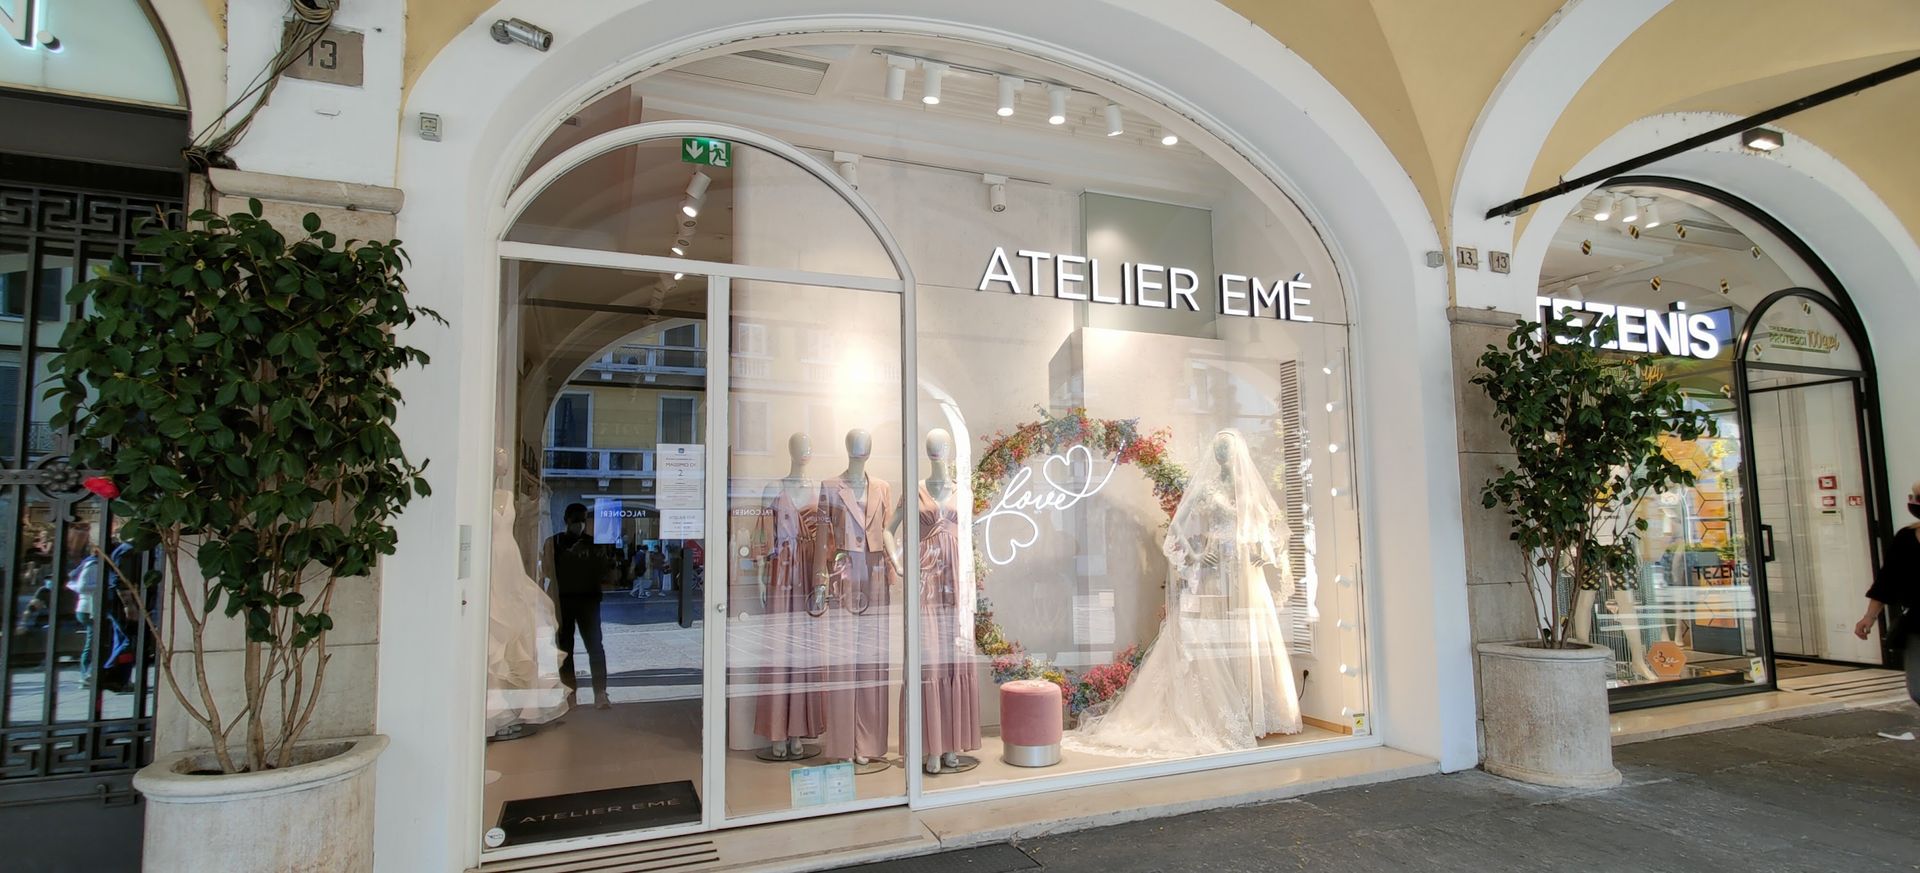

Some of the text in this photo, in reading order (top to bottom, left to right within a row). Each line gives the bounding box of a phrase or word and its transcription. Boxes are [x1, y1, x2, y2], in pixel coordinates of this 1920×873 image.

[307, 38, 337, 70] 13
[1496, 255, 1507, 269] 13
[978, 246, 1314, 322] ATELIER EMÉ
[520, 803, 623, 824] ATELIER
